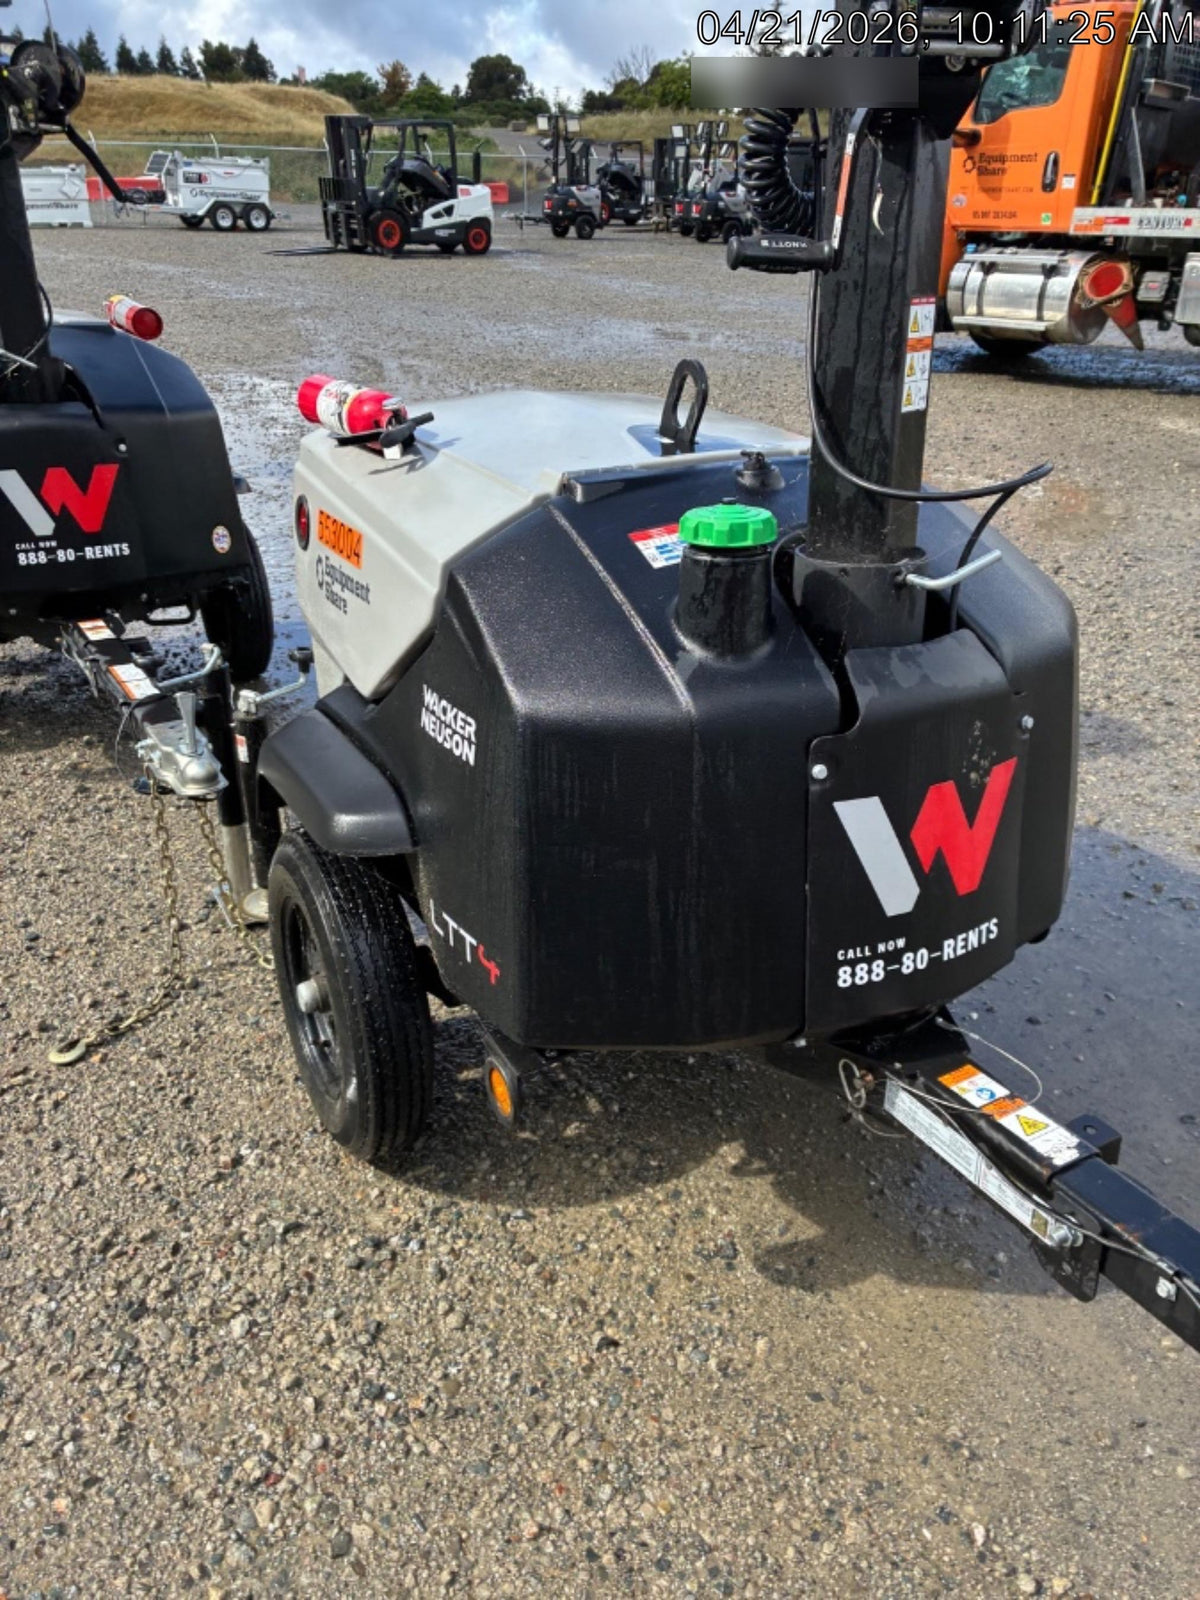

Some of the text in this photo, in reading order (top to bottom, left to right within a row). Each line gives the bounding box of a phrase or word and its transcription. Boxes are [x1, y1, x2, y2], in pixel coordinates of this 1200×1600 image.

[977, 165, 1008, 177] Share
[978, 151, 1038, 165] Equipment
[15, 540, 57, 551] CALL NOW
[17, 543, 130, 566] 888-80-RENTS
[325, 554, 370, 605] Equipment
[324, 580, 348, 615] Share
[422, 683, 477, 743] WACKER
[420, 706, 475, 767] NEUSON
[429, 898, 500, 985] LTT4
[836, 936, 907, 961] CALL NOW
[836, 917, 999, 988] 888-80-RENTS
